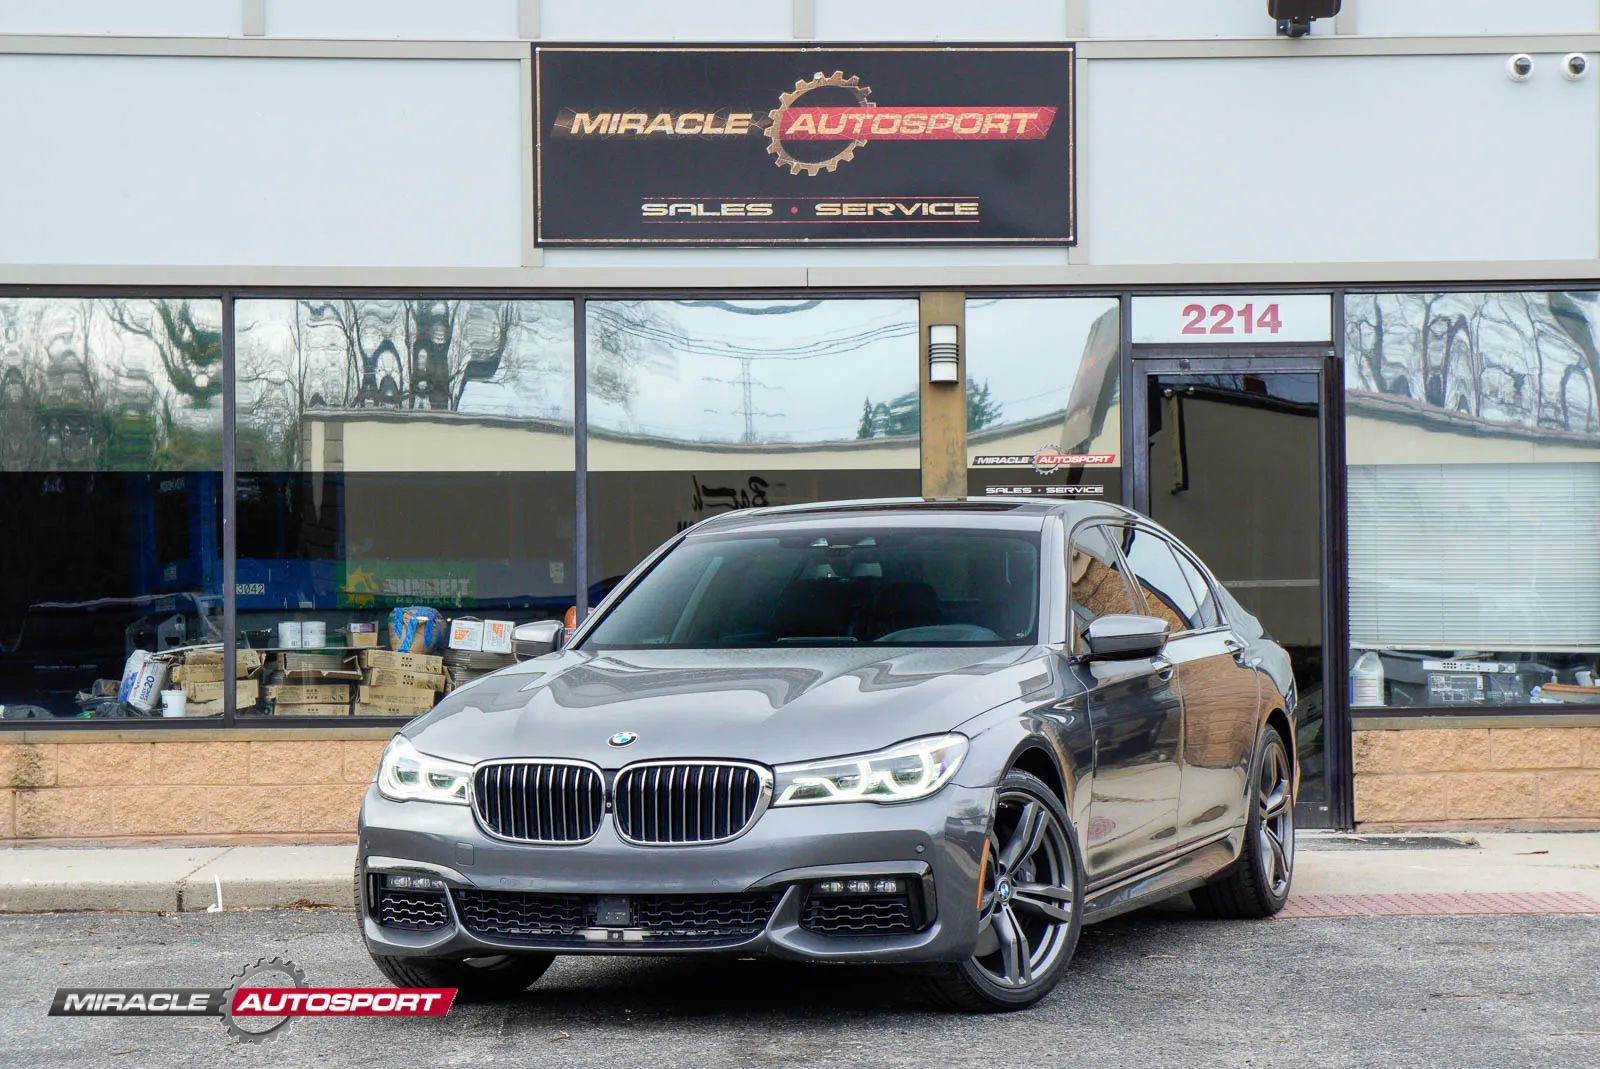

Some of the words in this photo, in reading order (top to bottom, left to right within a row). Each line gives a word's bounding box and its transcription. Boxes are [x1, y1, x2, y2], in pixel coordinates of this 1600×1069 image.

[570, 113, 753, 134] MIRACLE
[787, 112, 1038, 134] AUTOSPORT
[641, 203, 773, 216] SALES
[815, 202, 979, 216] SERVICE
[1181, 304, 1282, 335] 2214
[976, 456, 1030, 464] MIRACLE
[1037, 456, 1112, 464] AUTOSPORT
[1045, 486, 1104, 494] SERVICE
[144, 675, 155, 689] 20
